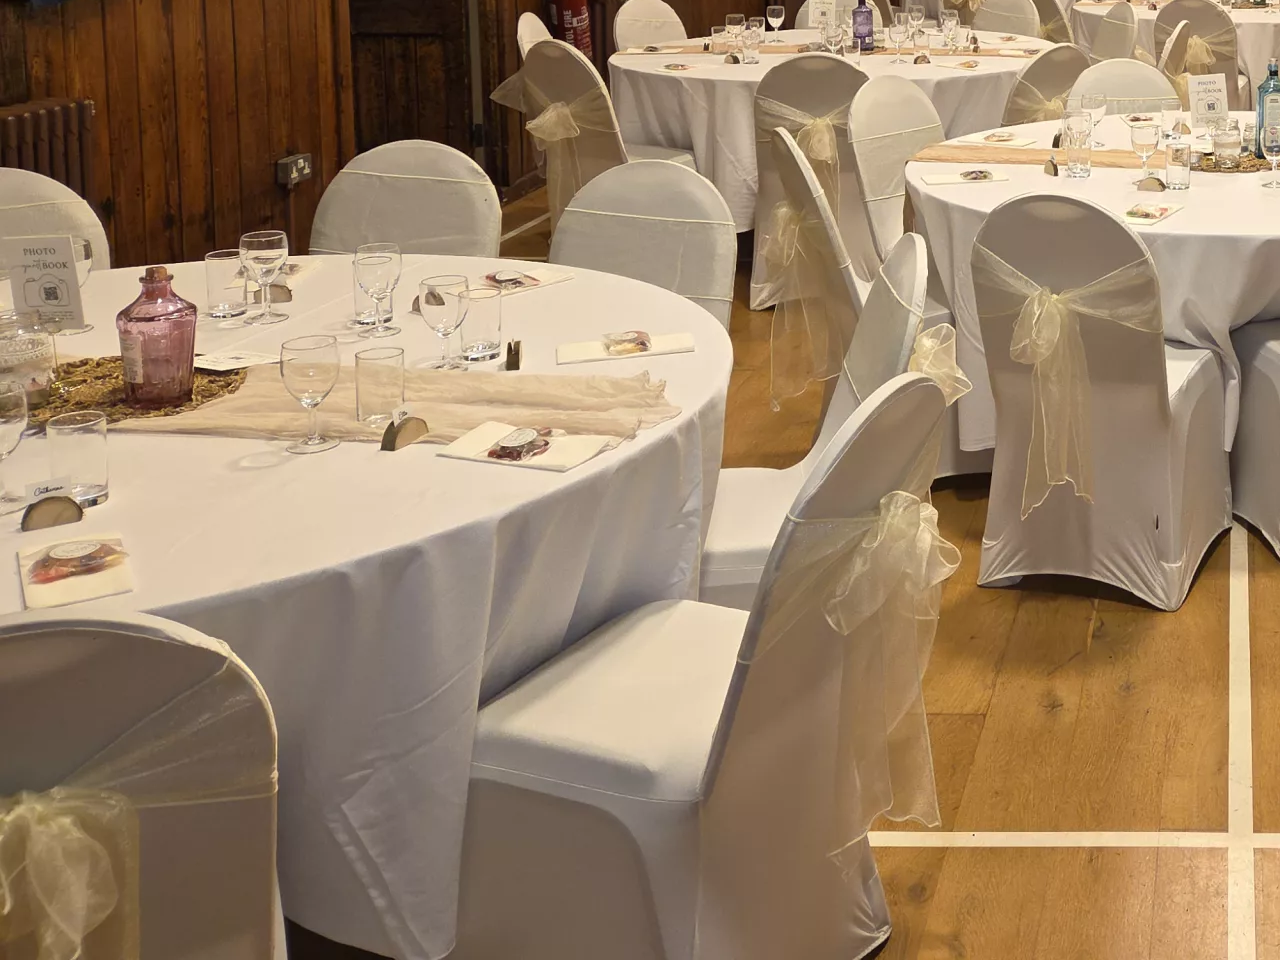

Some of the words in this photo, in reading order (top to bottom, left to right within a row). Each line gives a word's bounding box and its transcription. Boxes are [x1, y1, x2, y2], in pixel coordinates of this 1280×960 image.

[563, 9, 573, 28] FIRE
[22, 247, 56, 256] PHOTO
[42, 261, 69, 270] BOOK
